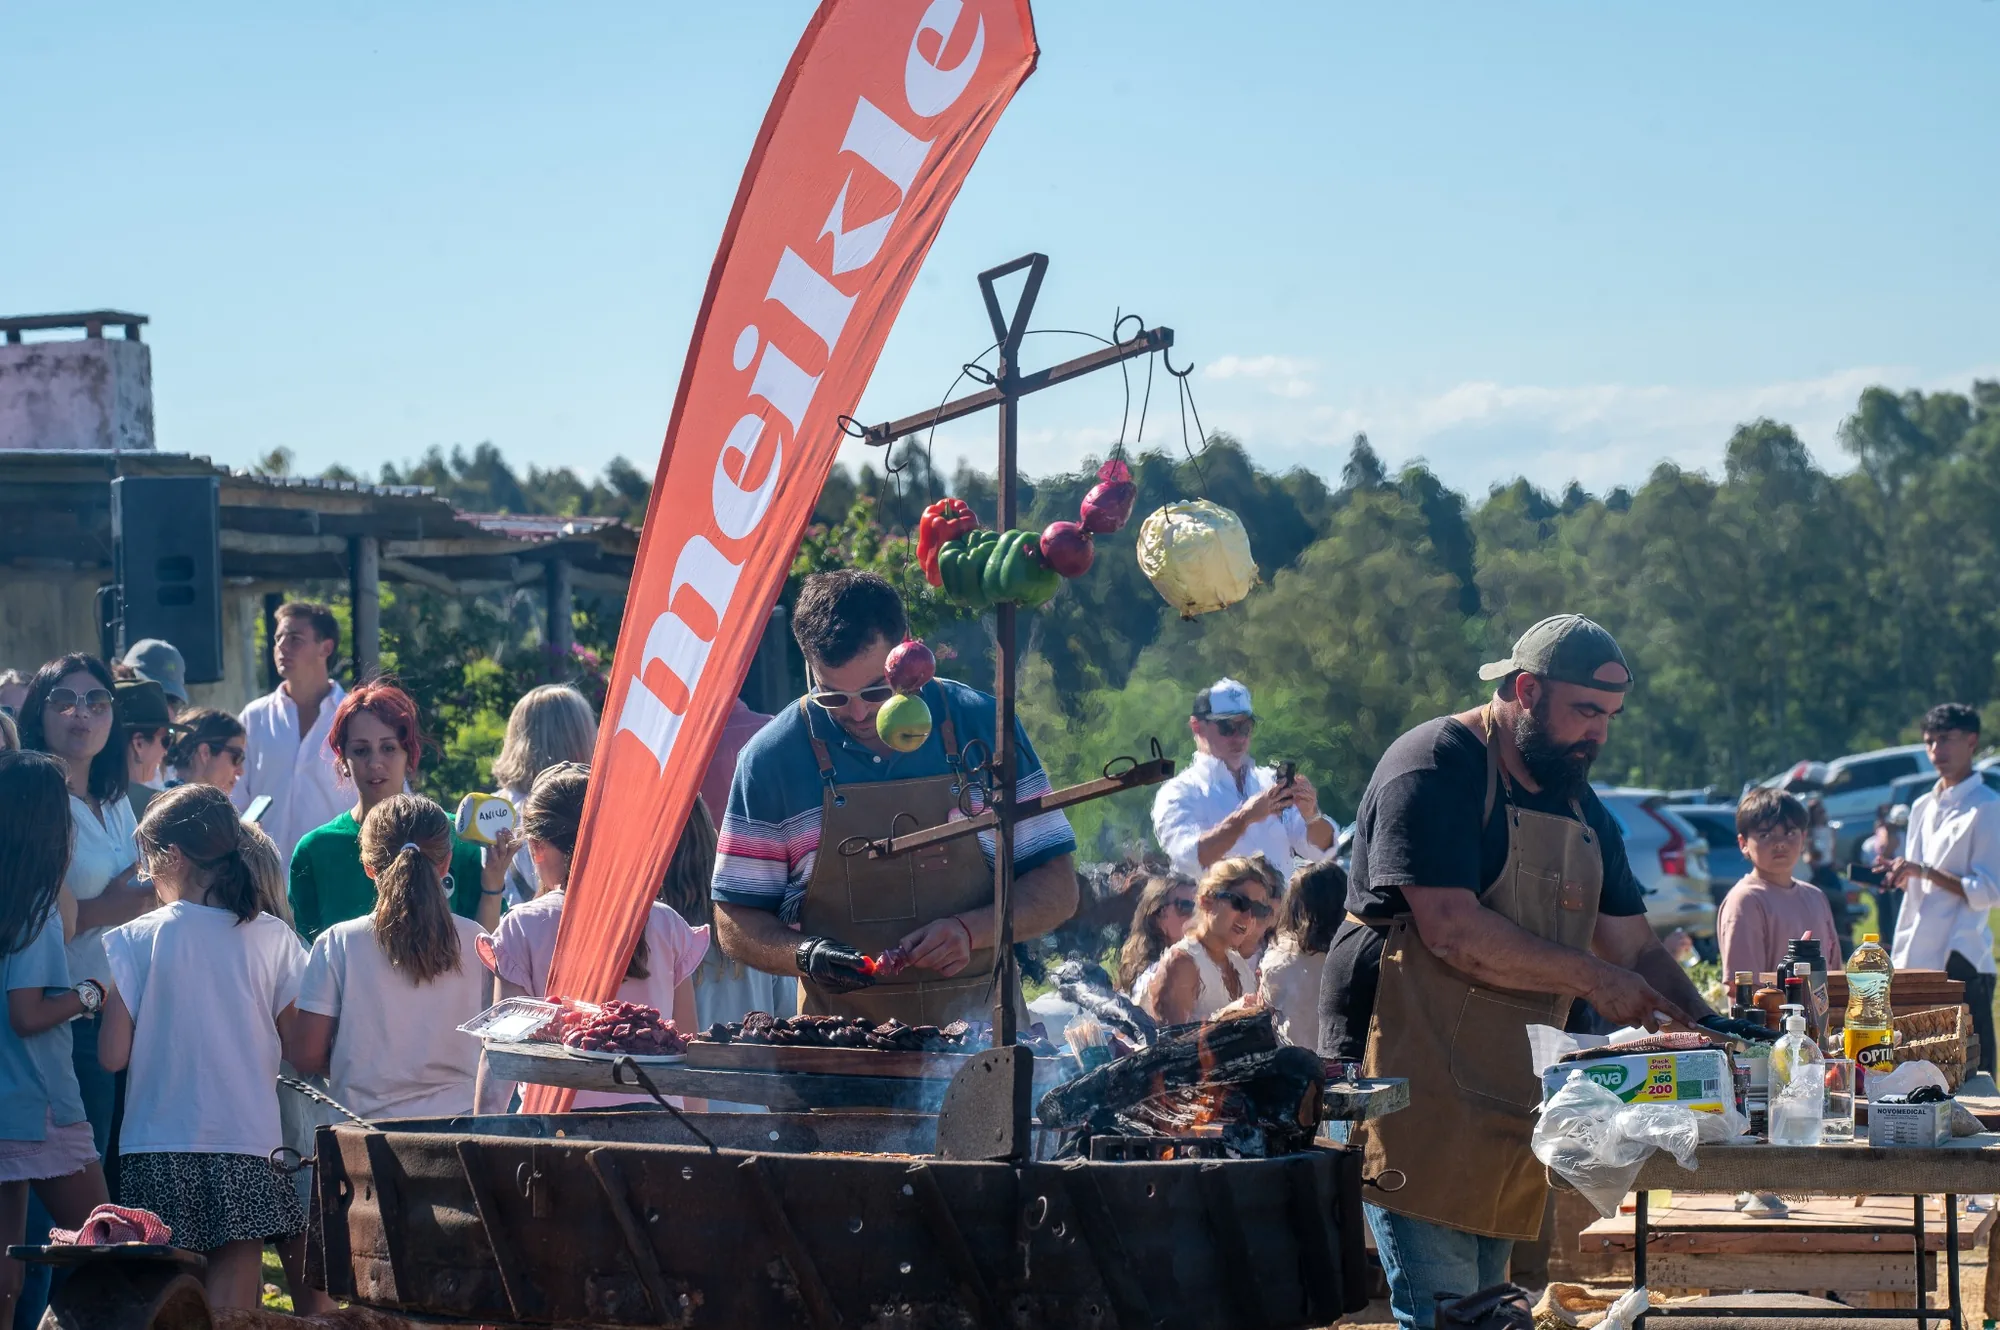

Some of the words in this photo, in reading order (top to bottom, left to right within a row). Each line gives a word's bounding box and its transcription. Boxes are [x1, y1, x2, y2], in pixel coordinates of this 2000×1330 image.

[614, 0, 985, 779] meikle
[1587, 1072, 1621, 1085] ova
[1653, 1074, 1672, 1084] 160
[1648, 1084, 1673, 1095] 200
